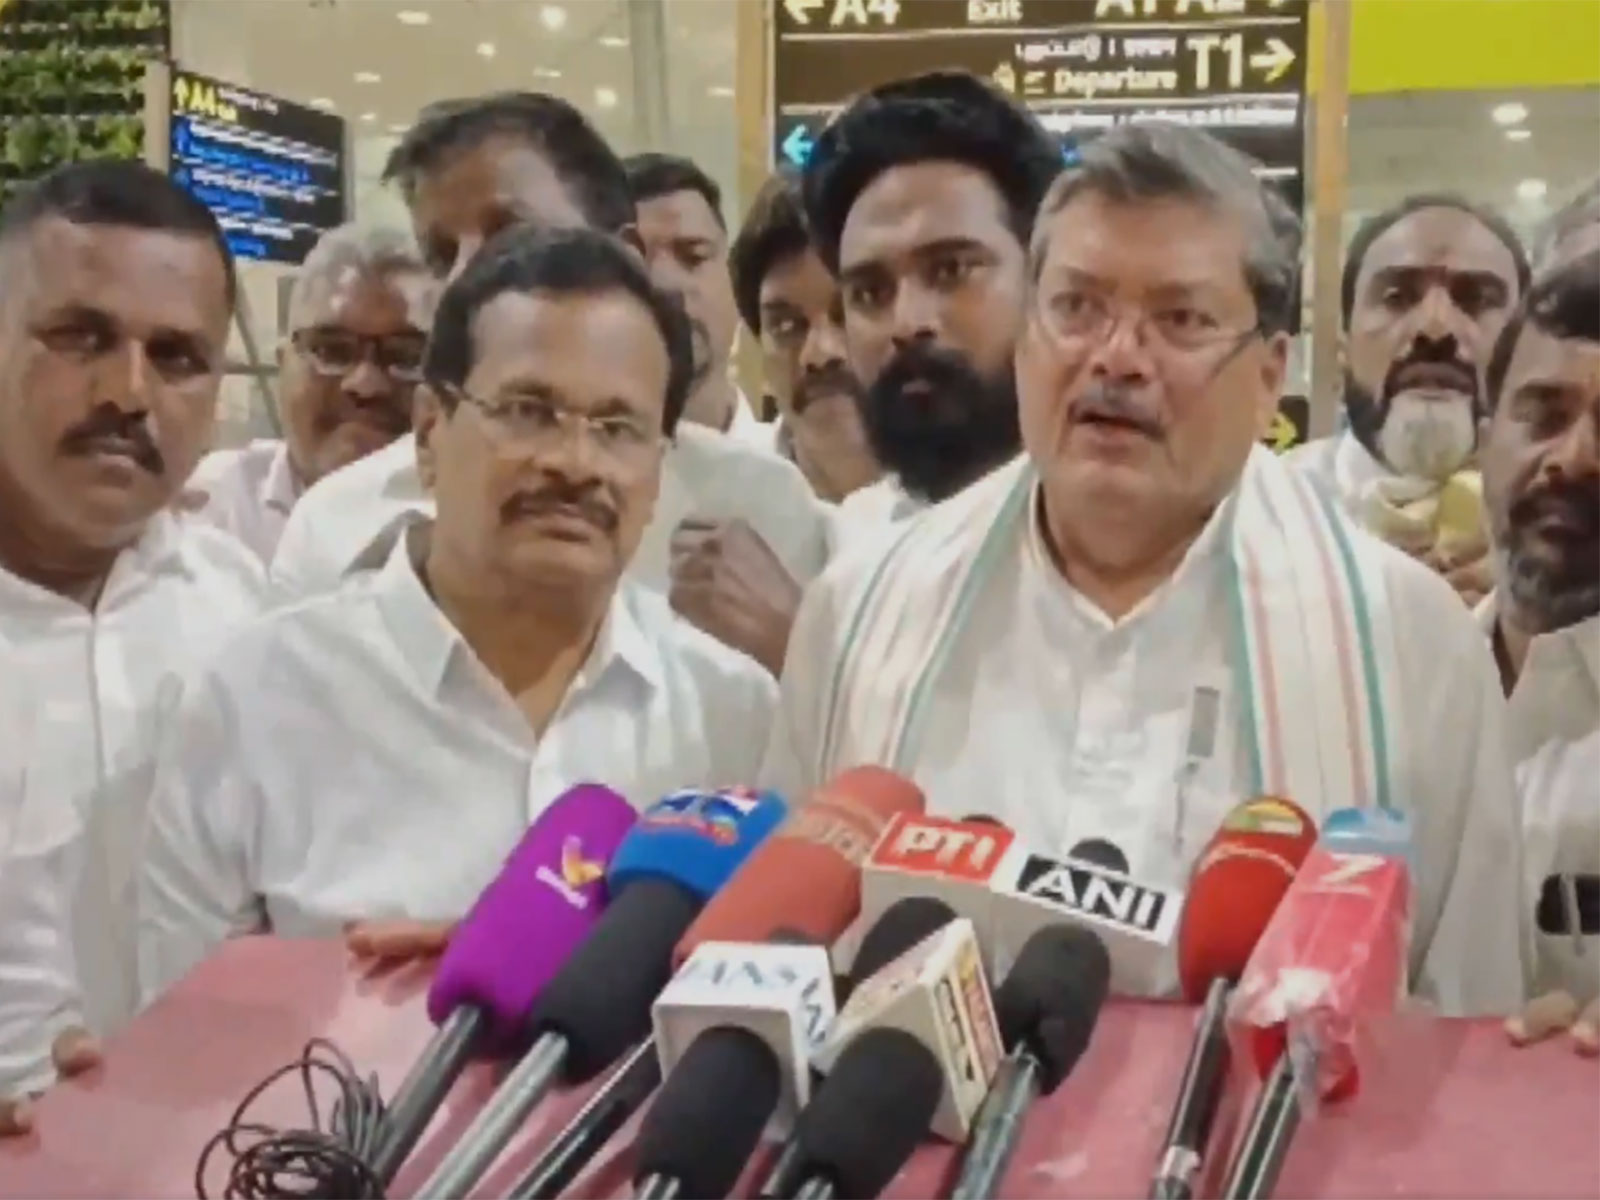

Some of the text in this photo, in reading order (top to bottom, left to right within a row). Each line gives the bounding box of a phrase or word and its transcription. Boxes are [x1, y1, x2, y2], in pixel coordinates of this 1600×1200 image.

[967, 0, 1023, 22] Exit
[1054, 65, 1178, 99] Departure
[1186, 33, 1243, 89] T1
[894, 824, 996, 871] PTI
[1024, 866, 1158, 927] ANI
